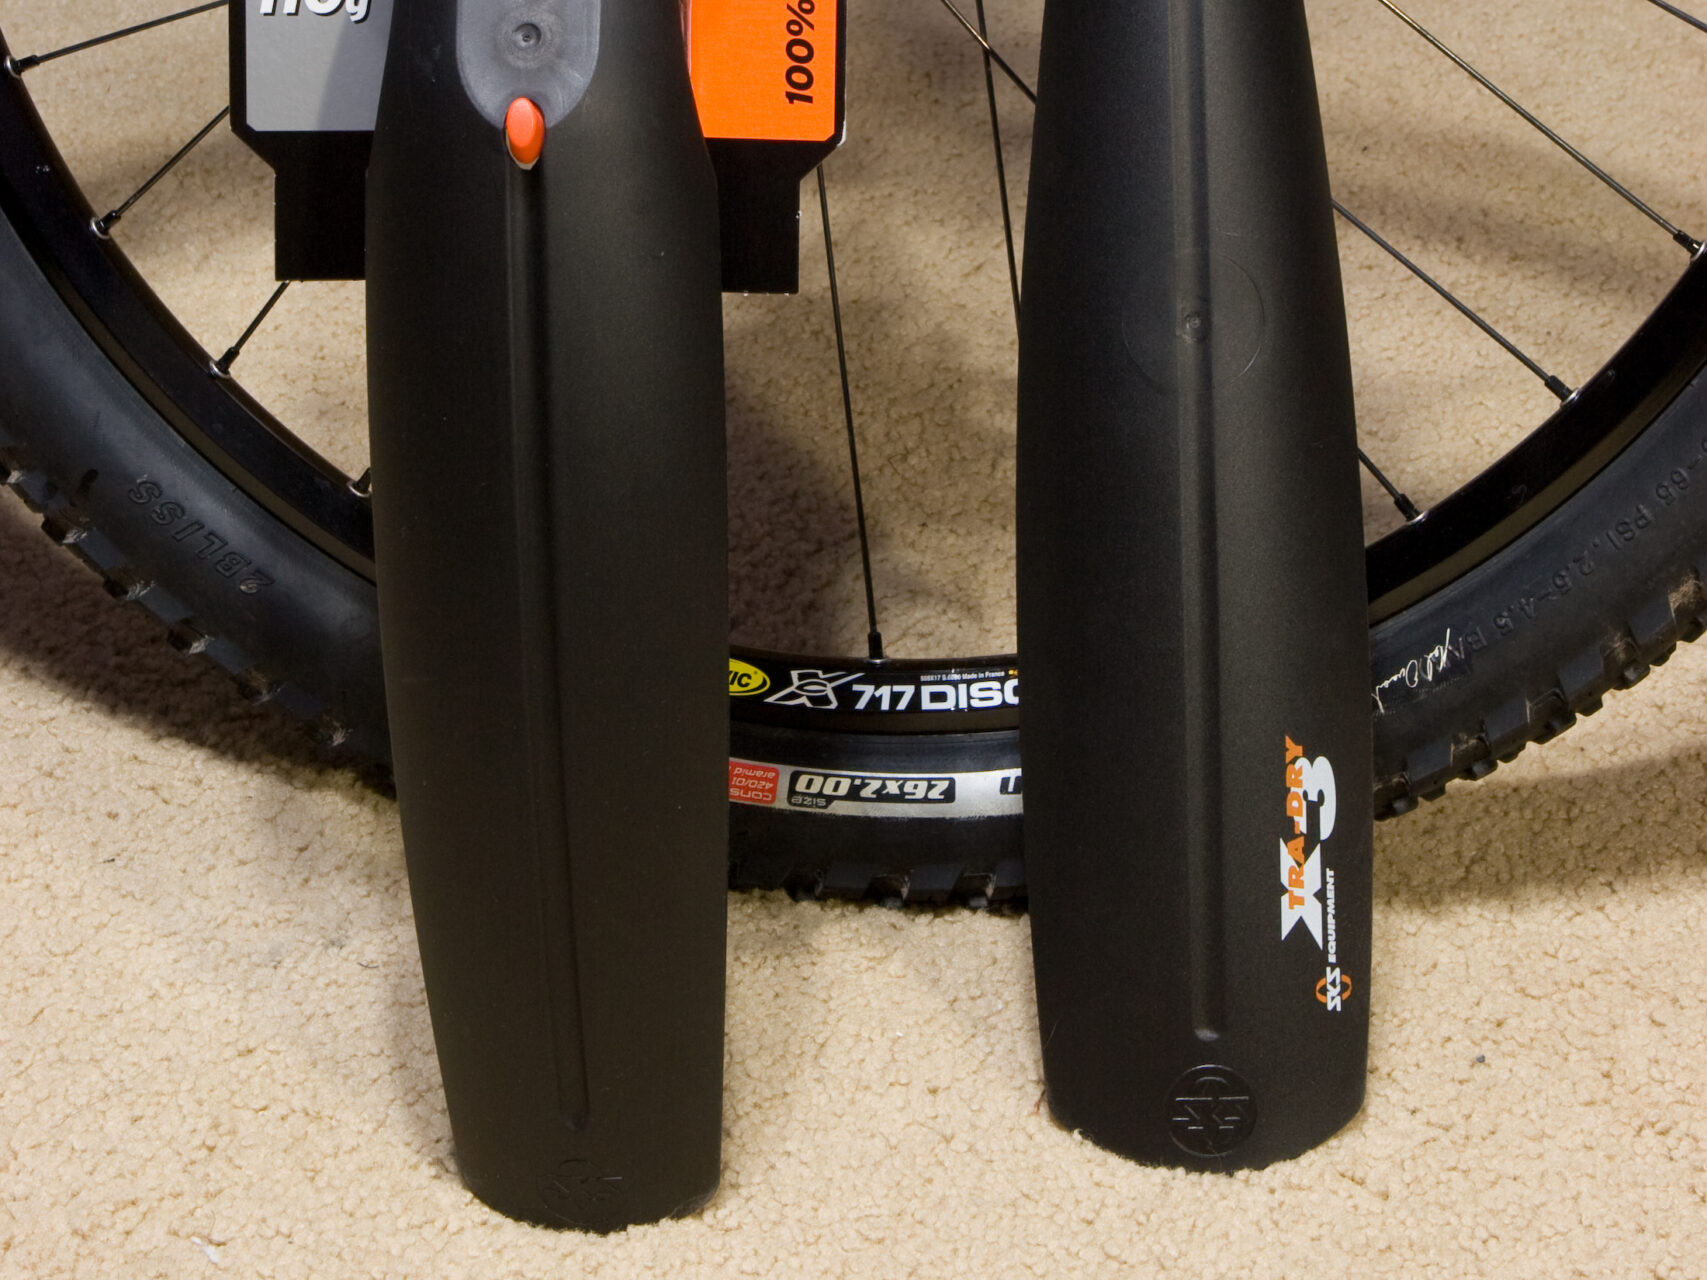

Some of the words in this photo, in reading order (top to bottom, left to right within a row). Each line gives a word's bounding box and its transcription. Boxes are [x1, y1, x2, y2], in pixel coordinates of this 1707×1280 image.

[851, 684, 916, 711] 717
[729, 788, 773, 801] cons
[795, 774, 951, 800] 26x2.00
[1325, 868, 1337, 963] EQUIPMENT
